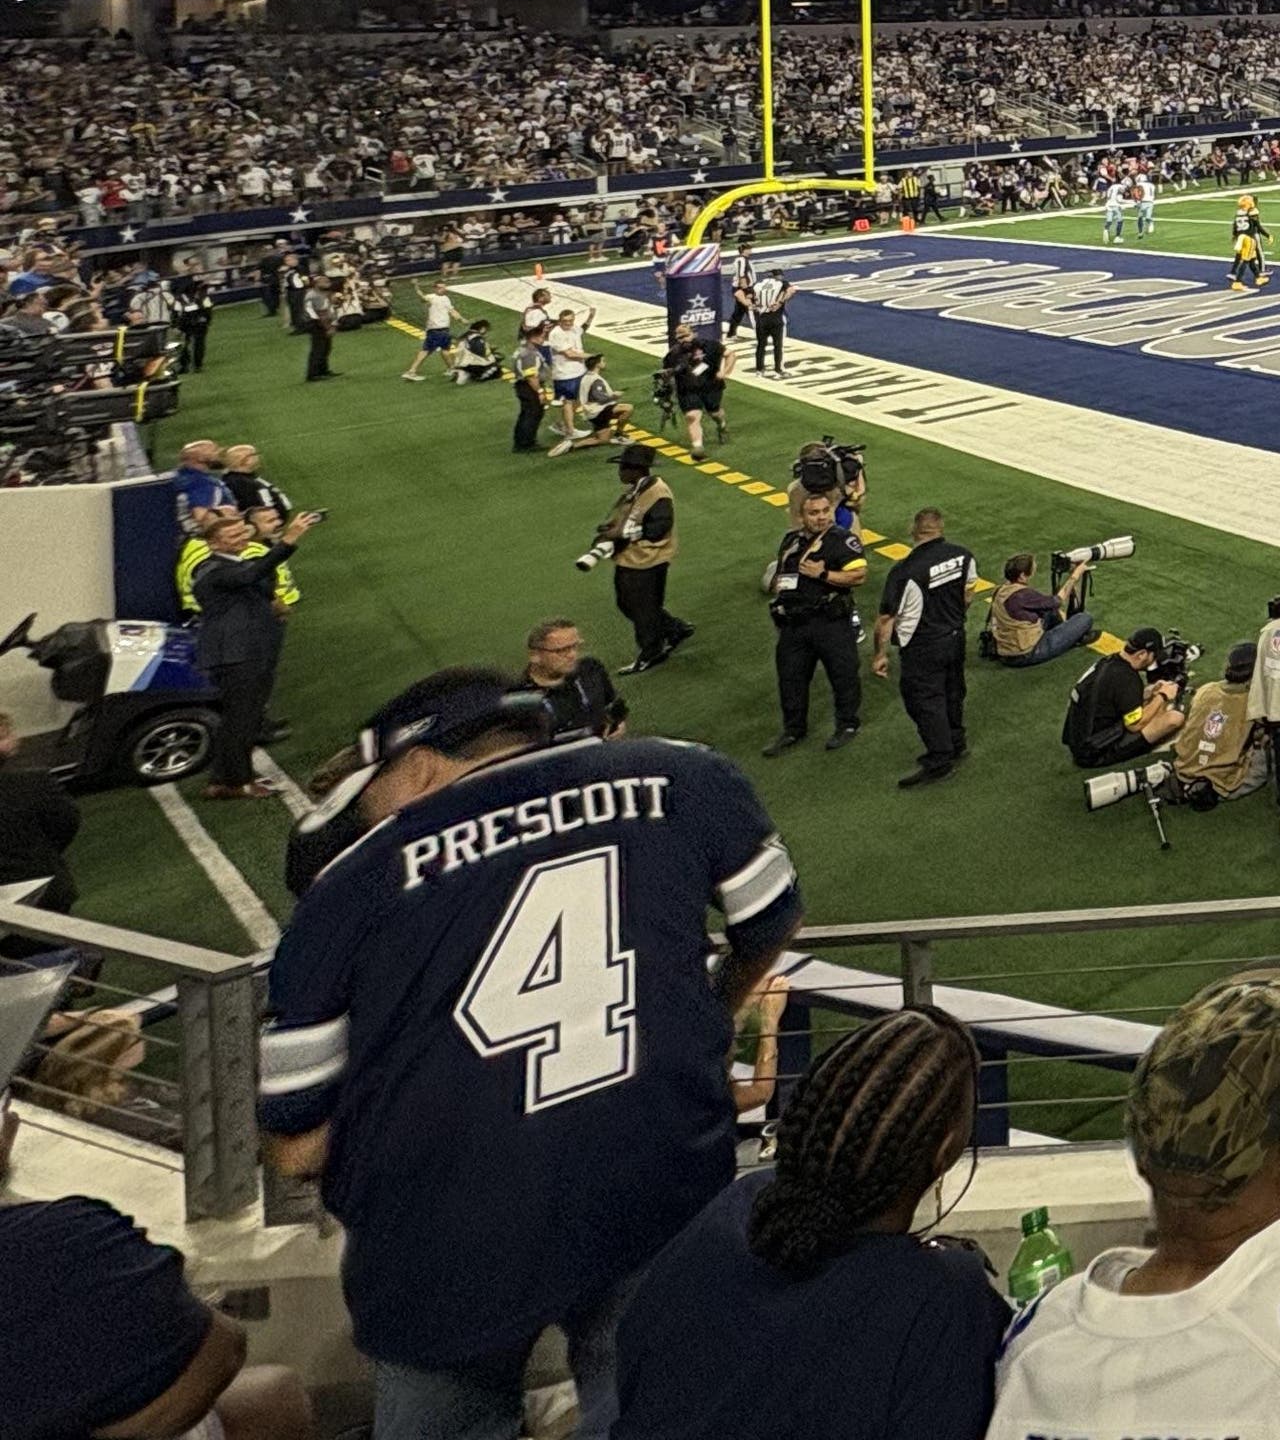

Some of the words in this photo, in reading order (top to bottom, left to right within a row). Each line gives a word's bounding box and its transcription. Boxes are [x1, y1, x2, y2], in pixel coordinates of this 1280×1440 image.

[680, 310, 716, 324] CATCH
[882, 394, 1022, 425] IT
[929, 555, 965, 578] BEST
[402, 775, 670, 891] PRESCOTT
[453, 843, 637, 1114] 4
